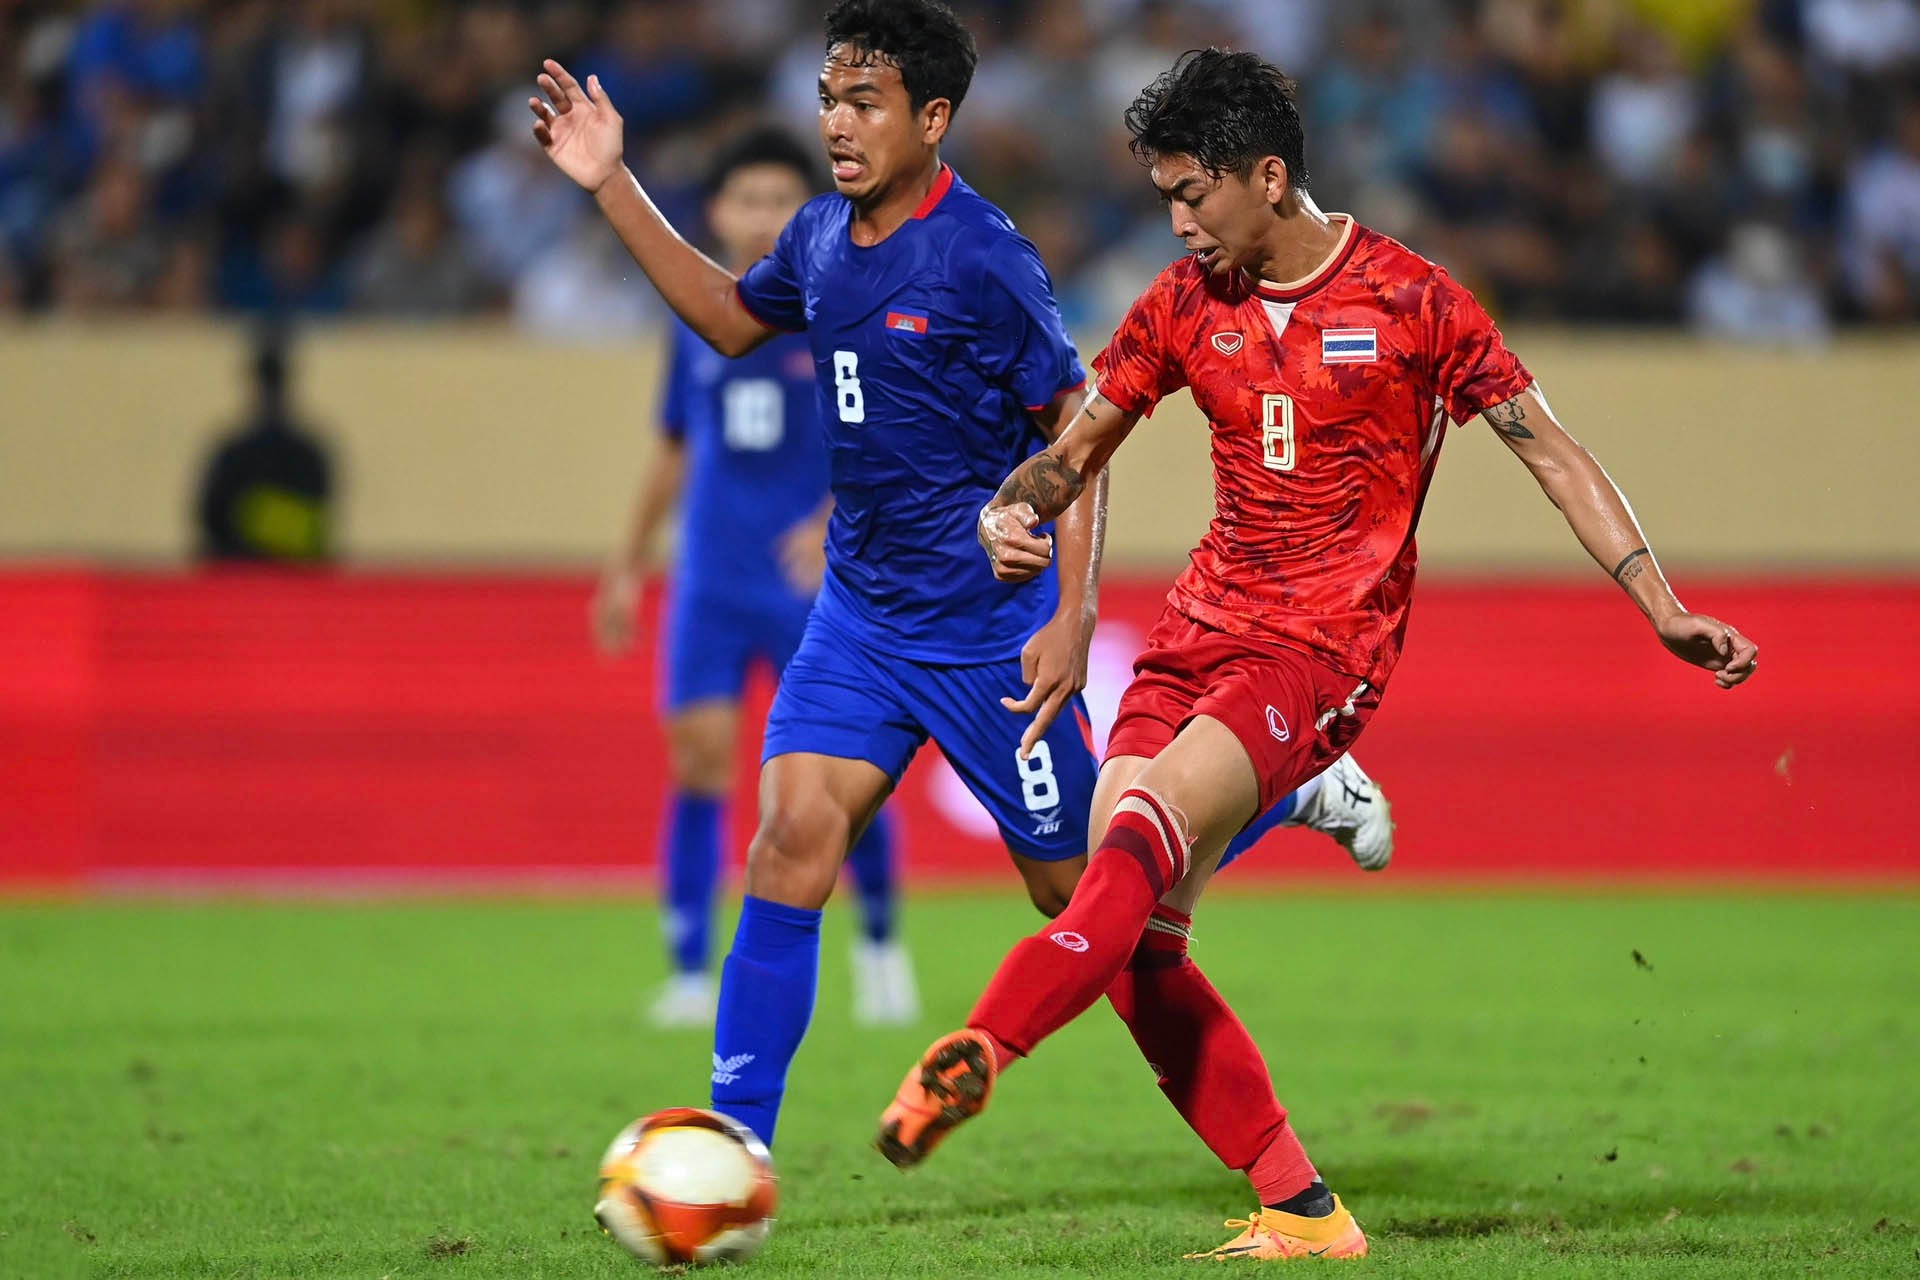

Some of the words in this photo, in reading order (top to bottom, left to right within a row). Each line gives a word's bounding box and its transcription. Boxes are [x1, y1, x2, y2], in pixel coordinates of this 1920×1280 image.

[833, 350, 864, 424] 8
[1262, 393, 1296, 472] 8
[1015, 740, 1060, 811] 8
